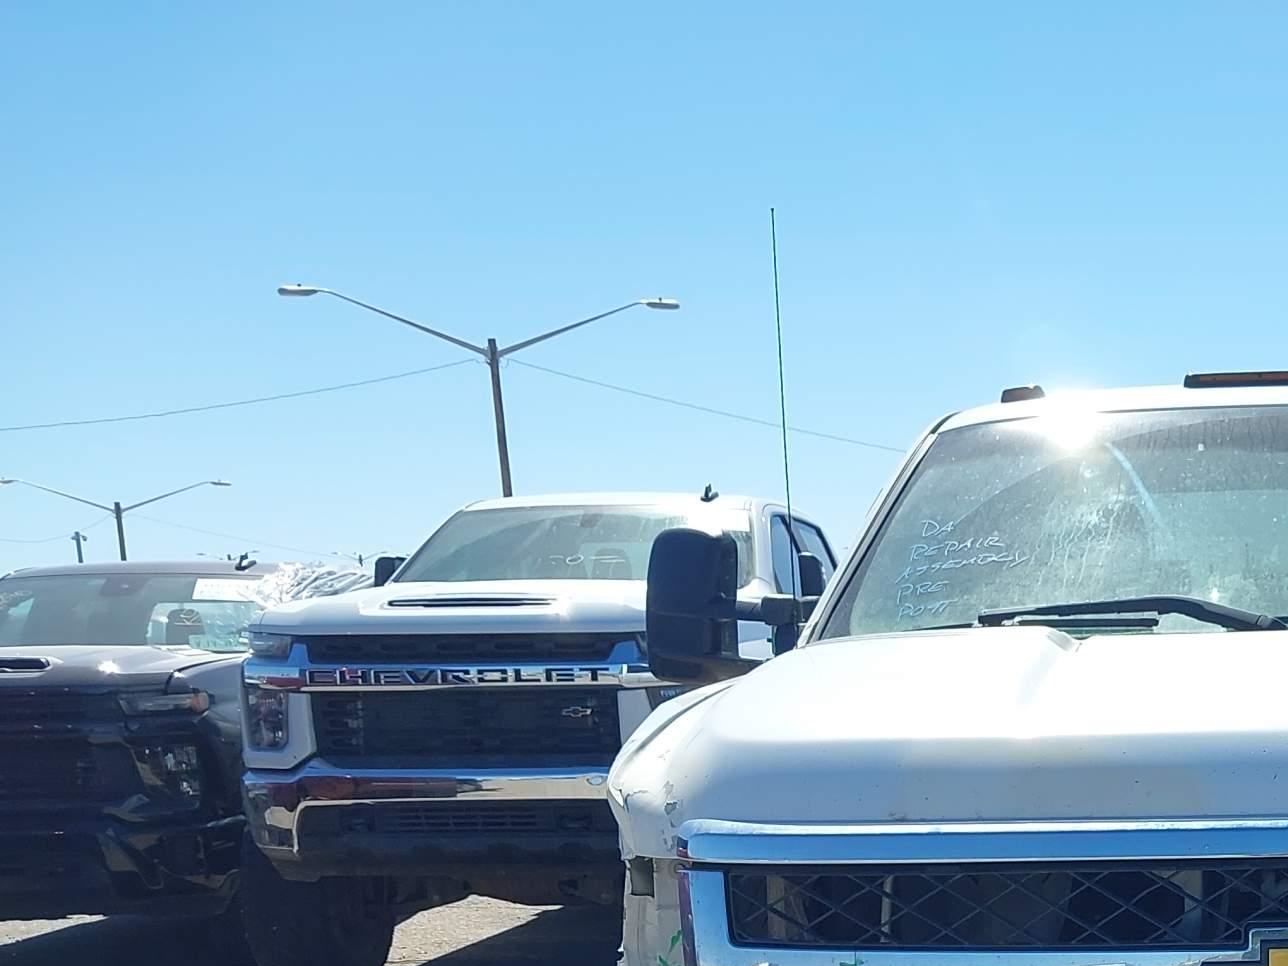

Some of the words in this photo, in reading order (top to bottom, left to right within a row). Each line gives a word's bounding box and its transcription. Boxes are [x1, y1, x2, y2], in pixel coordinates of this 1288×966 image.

[921, 519, 955, 537] DA
[909, 536, 1004, 561] REPAIR
[896, 581, 949, 603] PRE
[305, 667, 611, 686] CHEVROLET
